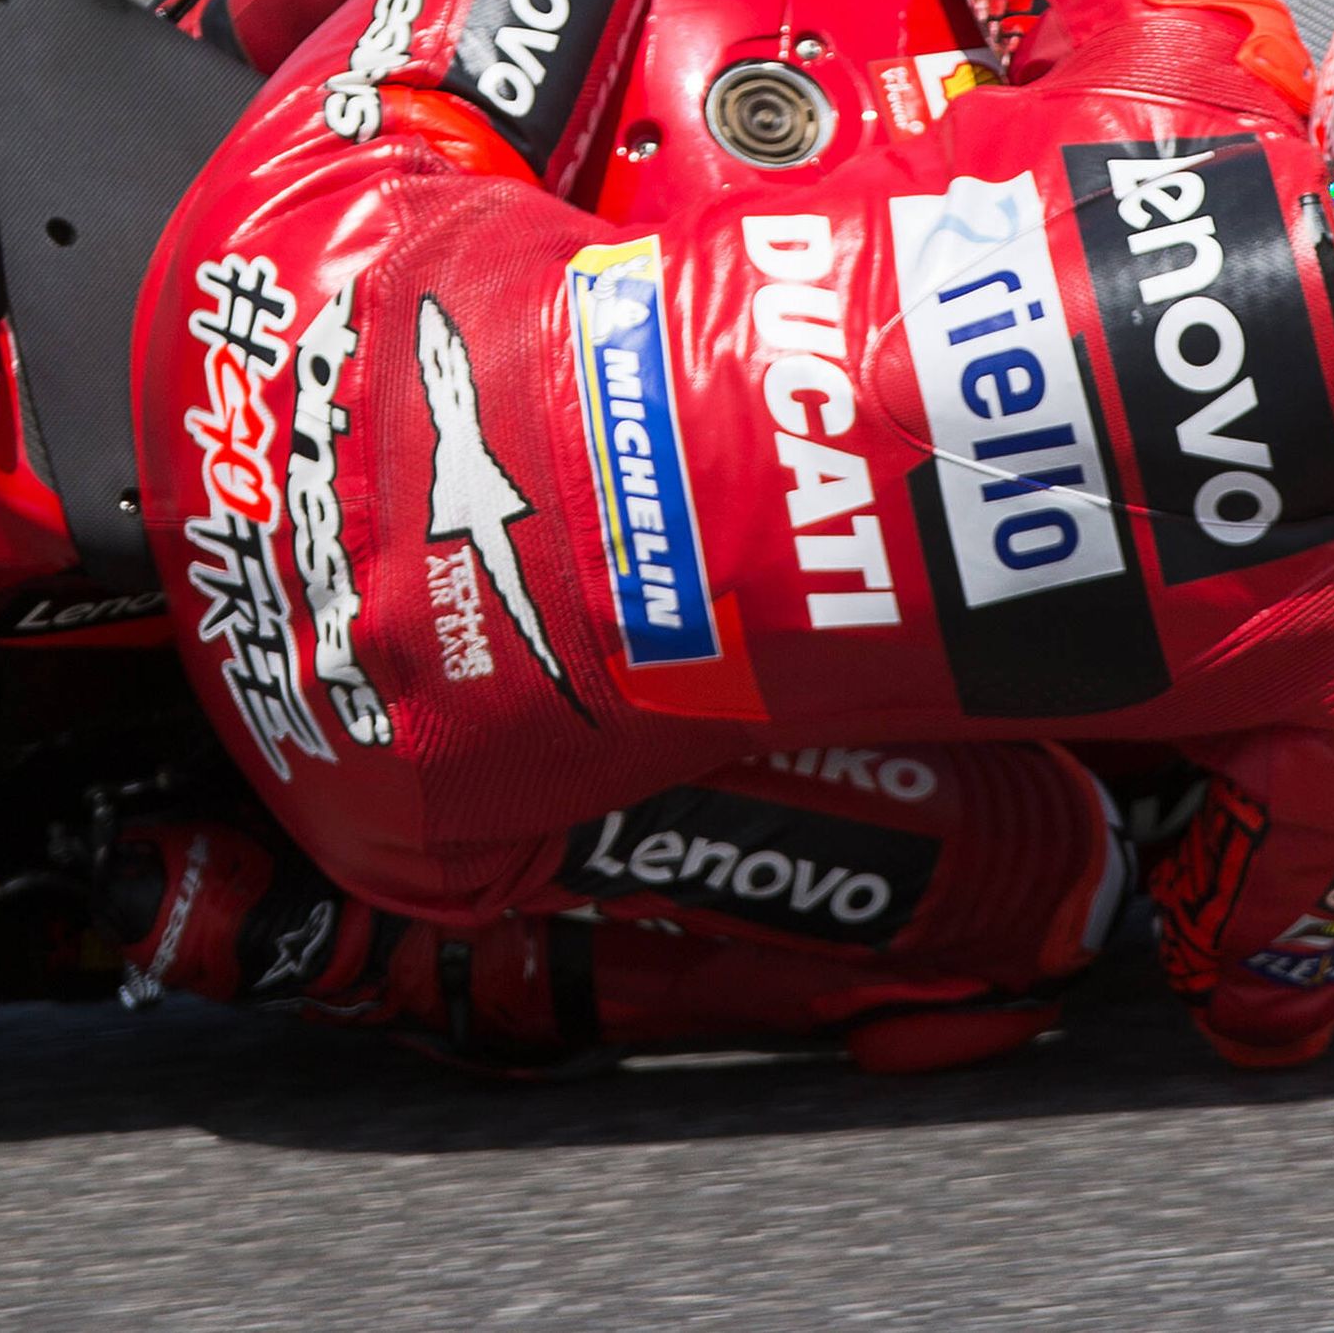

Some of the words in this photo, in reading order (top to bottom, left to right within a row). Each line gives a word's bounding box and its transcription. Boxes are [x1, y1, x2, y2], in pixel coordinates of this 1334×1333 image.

[602, 347, 683, 630] MICHELIN
[741, 212, 903, 630] DUCATI
[936, 267, 1081, 572] riello
[1106, 149, 1284, 547] Lenovo
[12, 589, 169, 631] Leno
[585, 813, 891, 925] Lenovo
